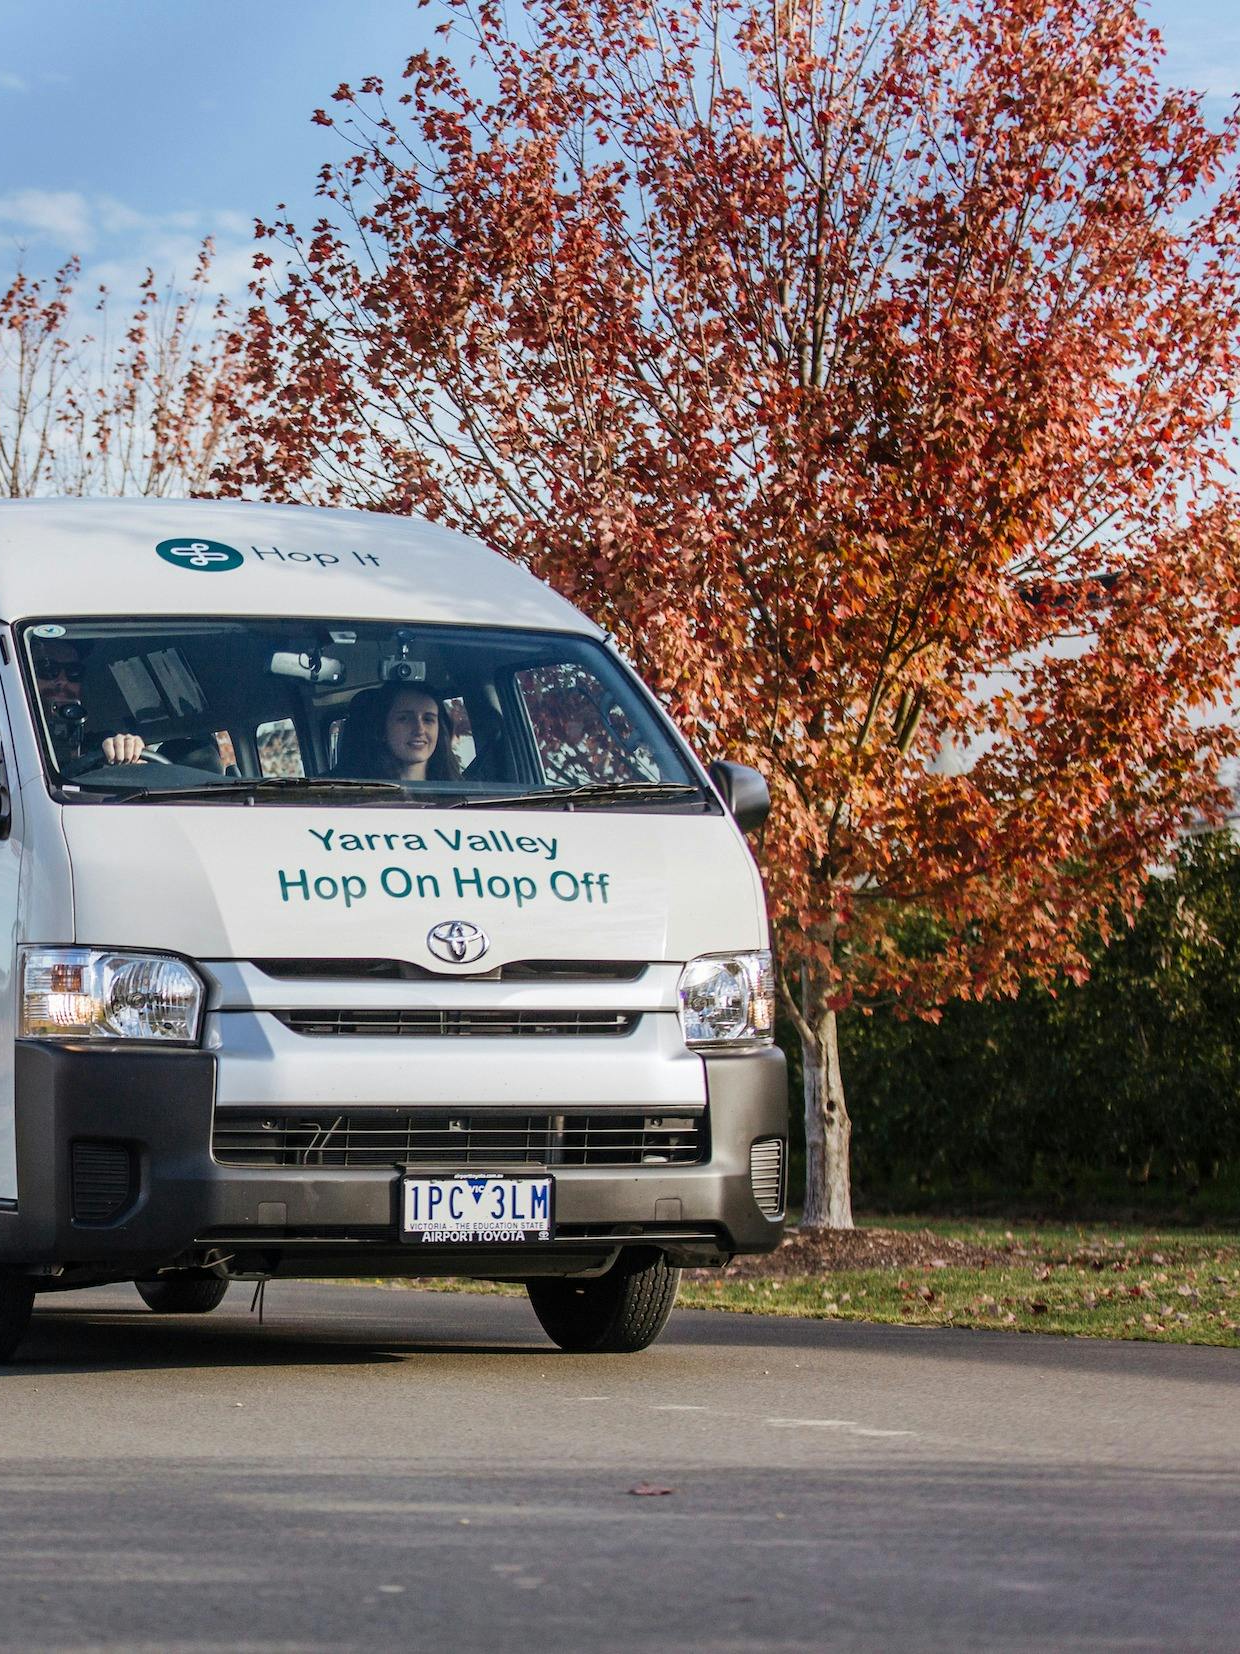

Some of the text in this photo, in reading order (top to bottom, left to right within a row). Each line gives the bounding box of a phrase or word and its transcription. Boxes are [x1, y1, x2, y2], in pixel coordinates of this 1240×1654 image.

[250, 546, 381, 567] Hop It
[308, 828, 558, 860] Yarra Valley
[278, 866, 610, 908] Hop On Hop Off
[411, 1184, 548, 1220] 1PC 3LM
[471, 1185, 485, 1193] VIC
[422, 1230, 526, 1242] AIRPORT TOYOTA
